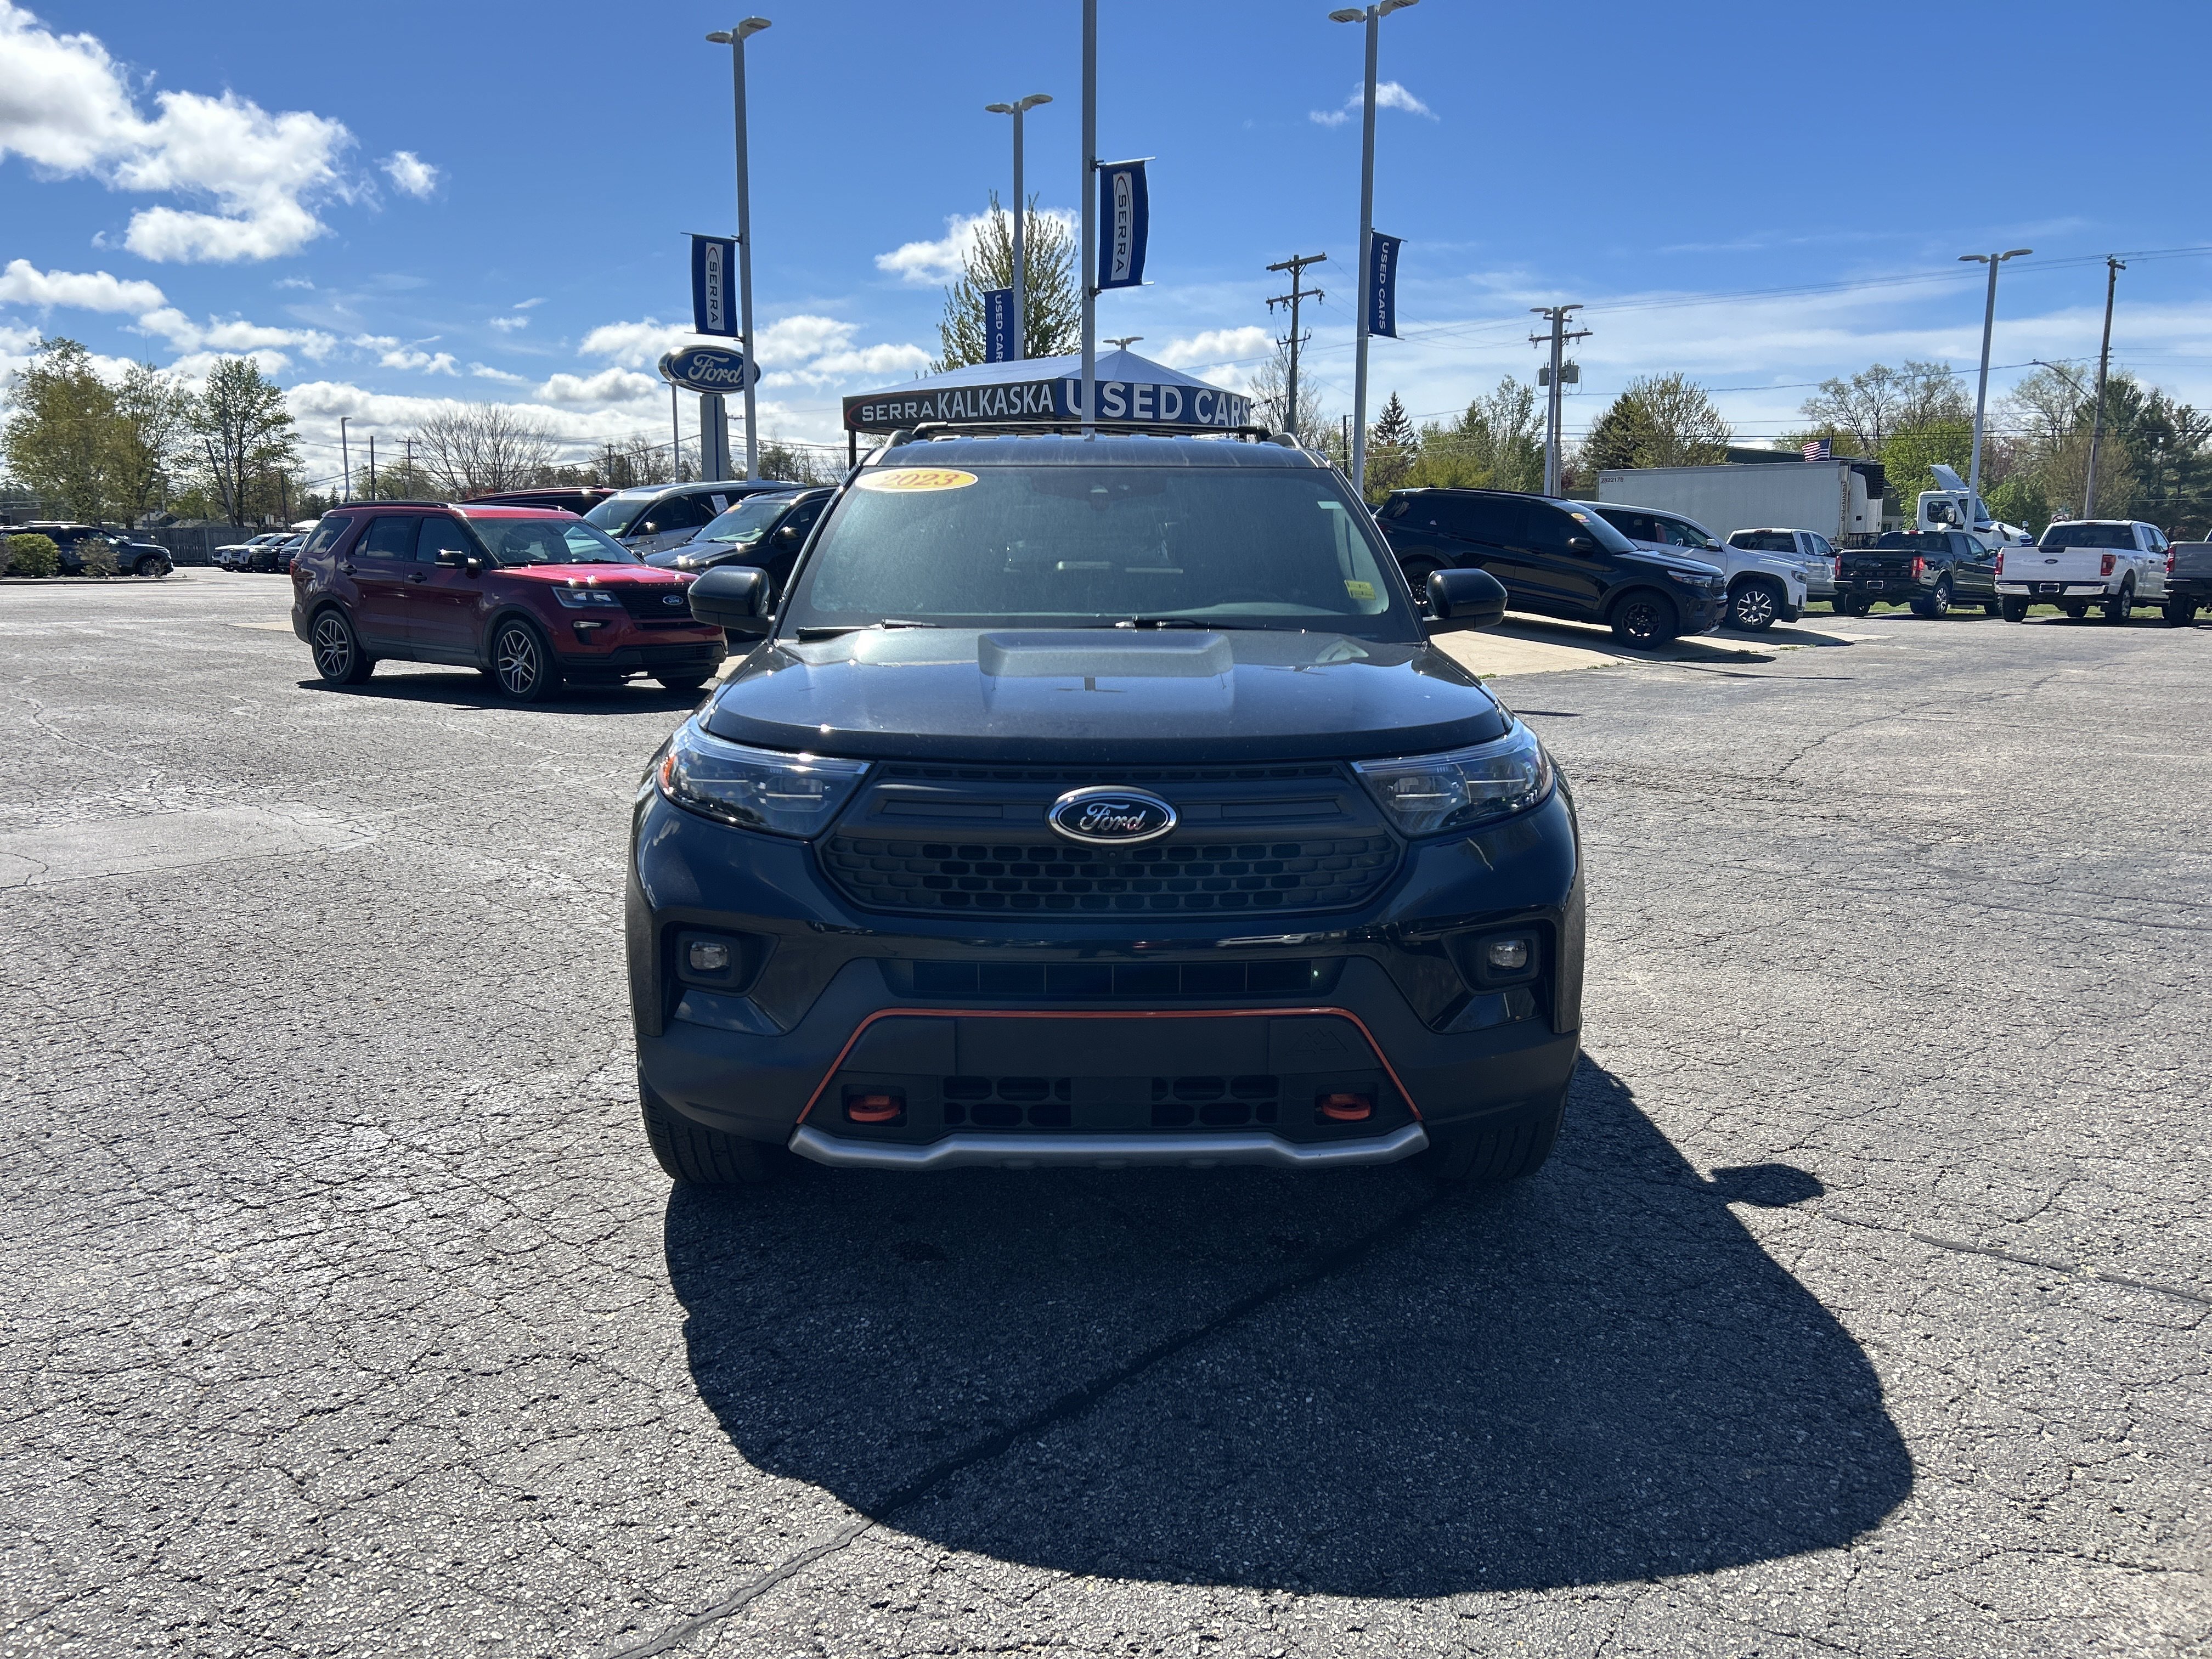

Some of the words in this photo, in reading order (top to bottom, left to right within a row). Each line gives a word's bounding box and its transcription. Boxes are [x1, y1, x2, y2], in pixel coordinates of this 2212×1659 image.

[1115, 194, 1127, 273] SERRA
[1379, 241, 1390, 285] USED
[709, 260, 719, 323] SERRA
[995, 294, 1003, 330] USED
[1378, 287, 1386, 330] CARS
[687, 353, 743, 383] Ford
[862, 400, 935, 422] SERRA
[937, 384, 1054, 420] KALKASKA
[1194, 389, 1250, 427] CARS
[876, 473, 960, 487] 2023
[1079, 802, 1147, 831] Ford
